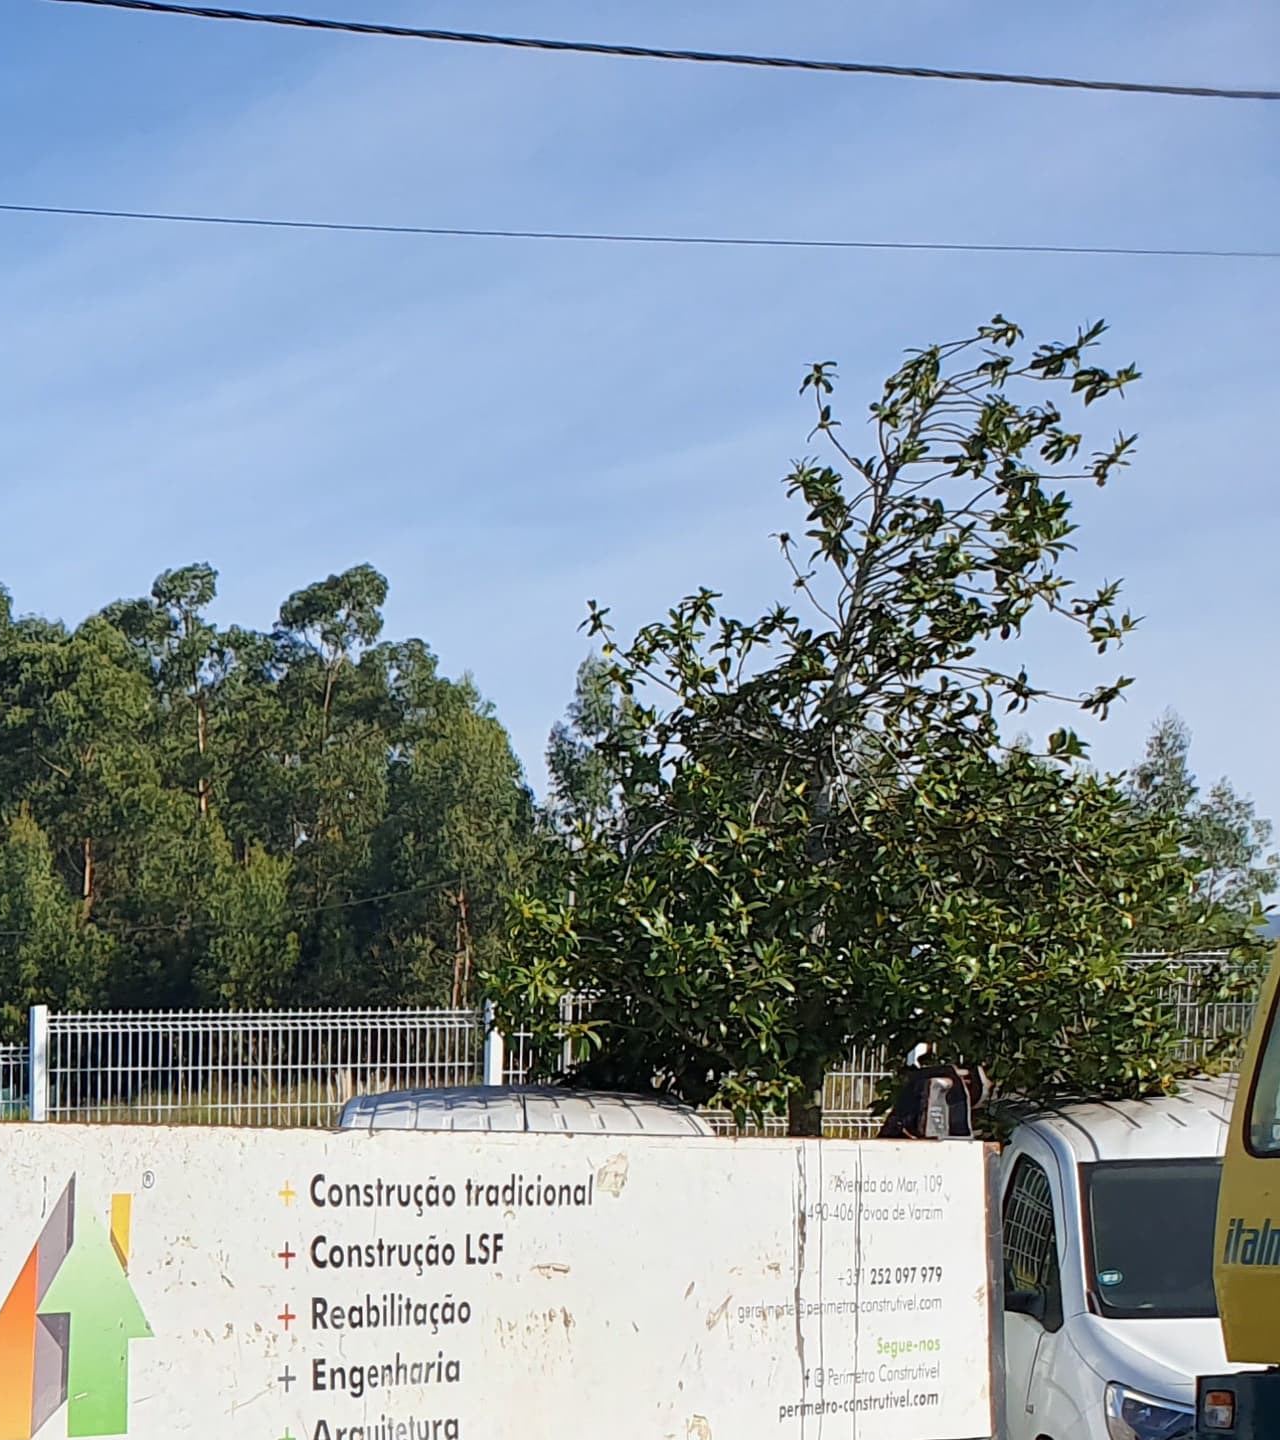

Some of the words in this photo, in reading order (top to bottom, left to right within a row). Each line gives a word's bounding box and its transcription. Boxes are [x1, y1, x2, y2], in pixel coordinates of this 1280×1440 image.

[310, 1173, 456, 1217] Construção
[466, 1173, 593, 1207] tradicional
[880, 1175, 893, 1193] do
[896, 1175, 919, 1196] Mar,
[923, 1174, 943, 1193] 109
[801, 1203, 854, 1222] 490-406
[892, 1202, 906, 1221] de
[909, 1203, 943, 1221] Varzim
[310, 1234, 456, 1276] Construção
[465, 1233, 504, 1265] LSF
[870, 1266, 891, 1286] 252
[895, 1266, 917, 1285] 097
[920, 1265, 943, 1284] 979
[311, 1293, 472, 1335] Reabilitação
[876, 1336, 941, 1358] Segue-nos
[312, 1350, 461, 1398] Engenharia
